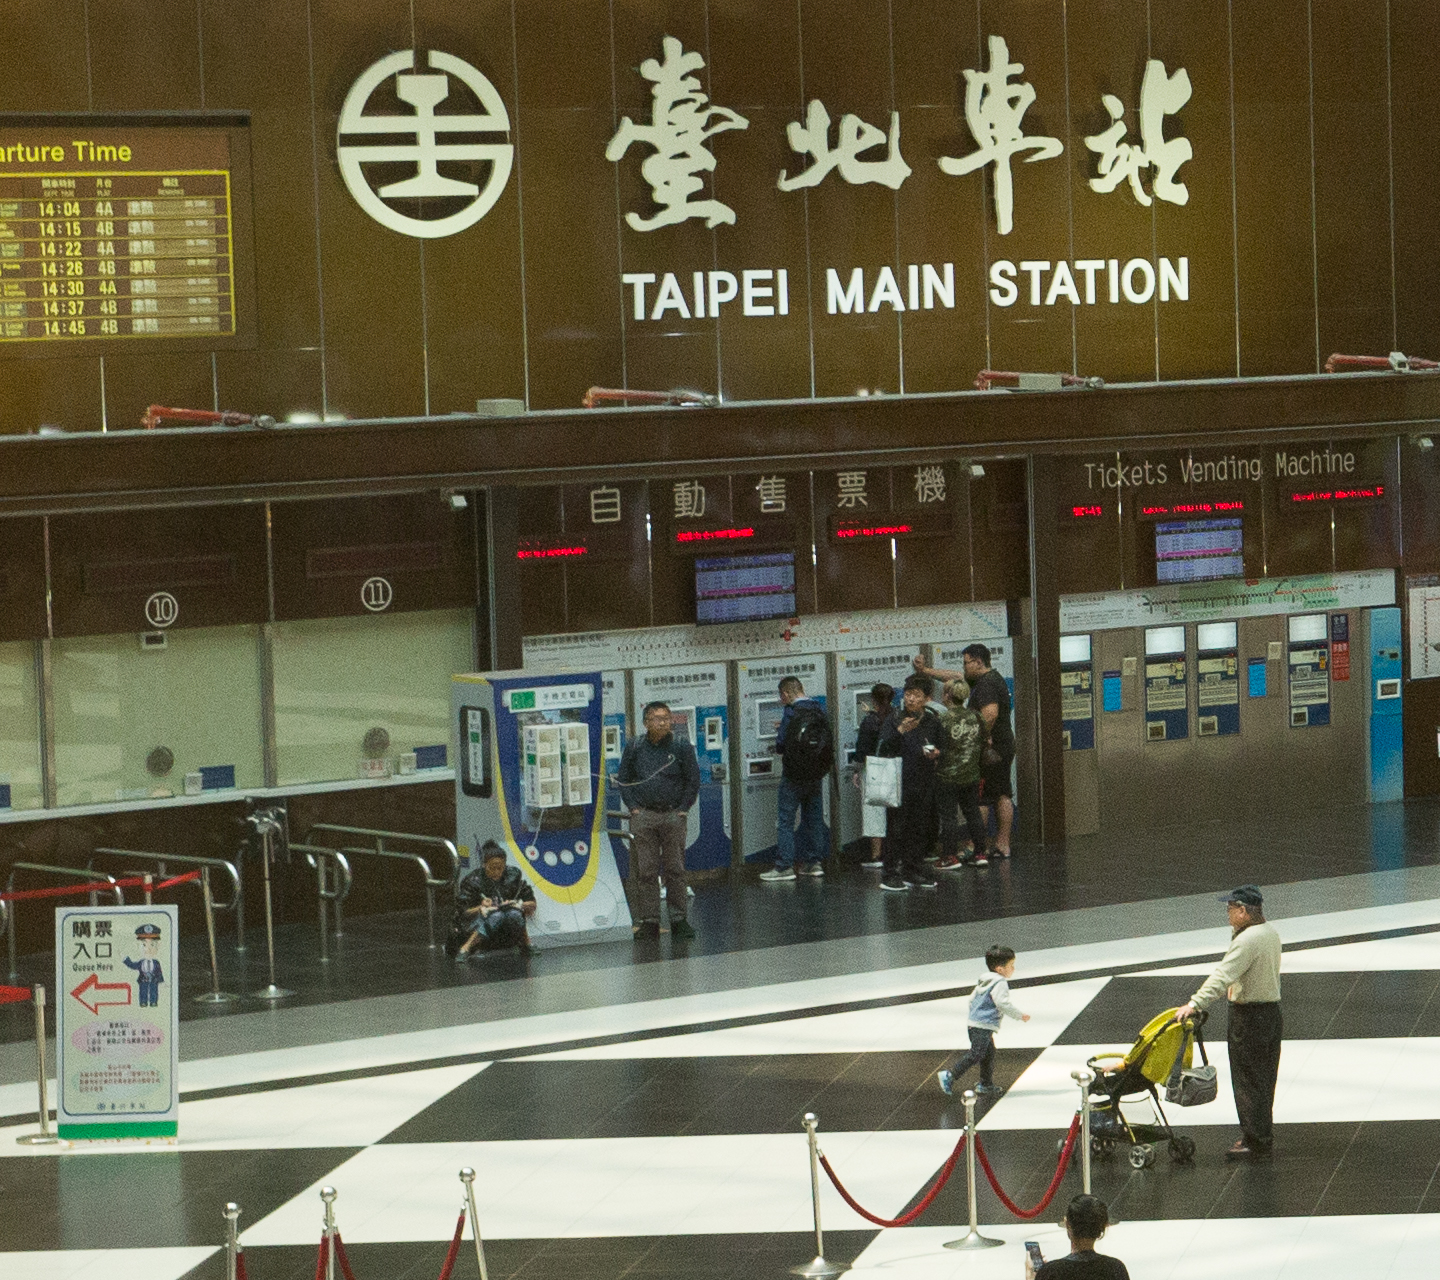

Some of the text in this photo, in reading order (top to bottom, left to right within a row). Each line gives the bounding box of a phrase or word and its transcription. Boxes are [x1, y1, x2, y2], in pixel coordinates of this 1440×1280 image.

[604, 35, 1193, 235] 臺北車站
[72, 140, 133, 163] Time
[39, 201, 114, 217] 14:04 4A
[39, 221, 114, 237] 14:15 4B
[40, 241, 115, 257] 14:22 4A
[41, 261, 116, 277] 14:26 4B
[42, 280, 117, 296] 14:30 4A
[622, 256, 1190, 321] TAIPEI MAIN STATION
[43, 300, 117, 316] 14:37 4B
[44, 320, 118, 336] 14:45 4B
[1084, 450, 1356, 489] Tickets Vending Machine
[590, 465, 947, 523] 自動售票機
[72, 920, 114, 939] 購票
[72, 942, 113, 959] 入口
